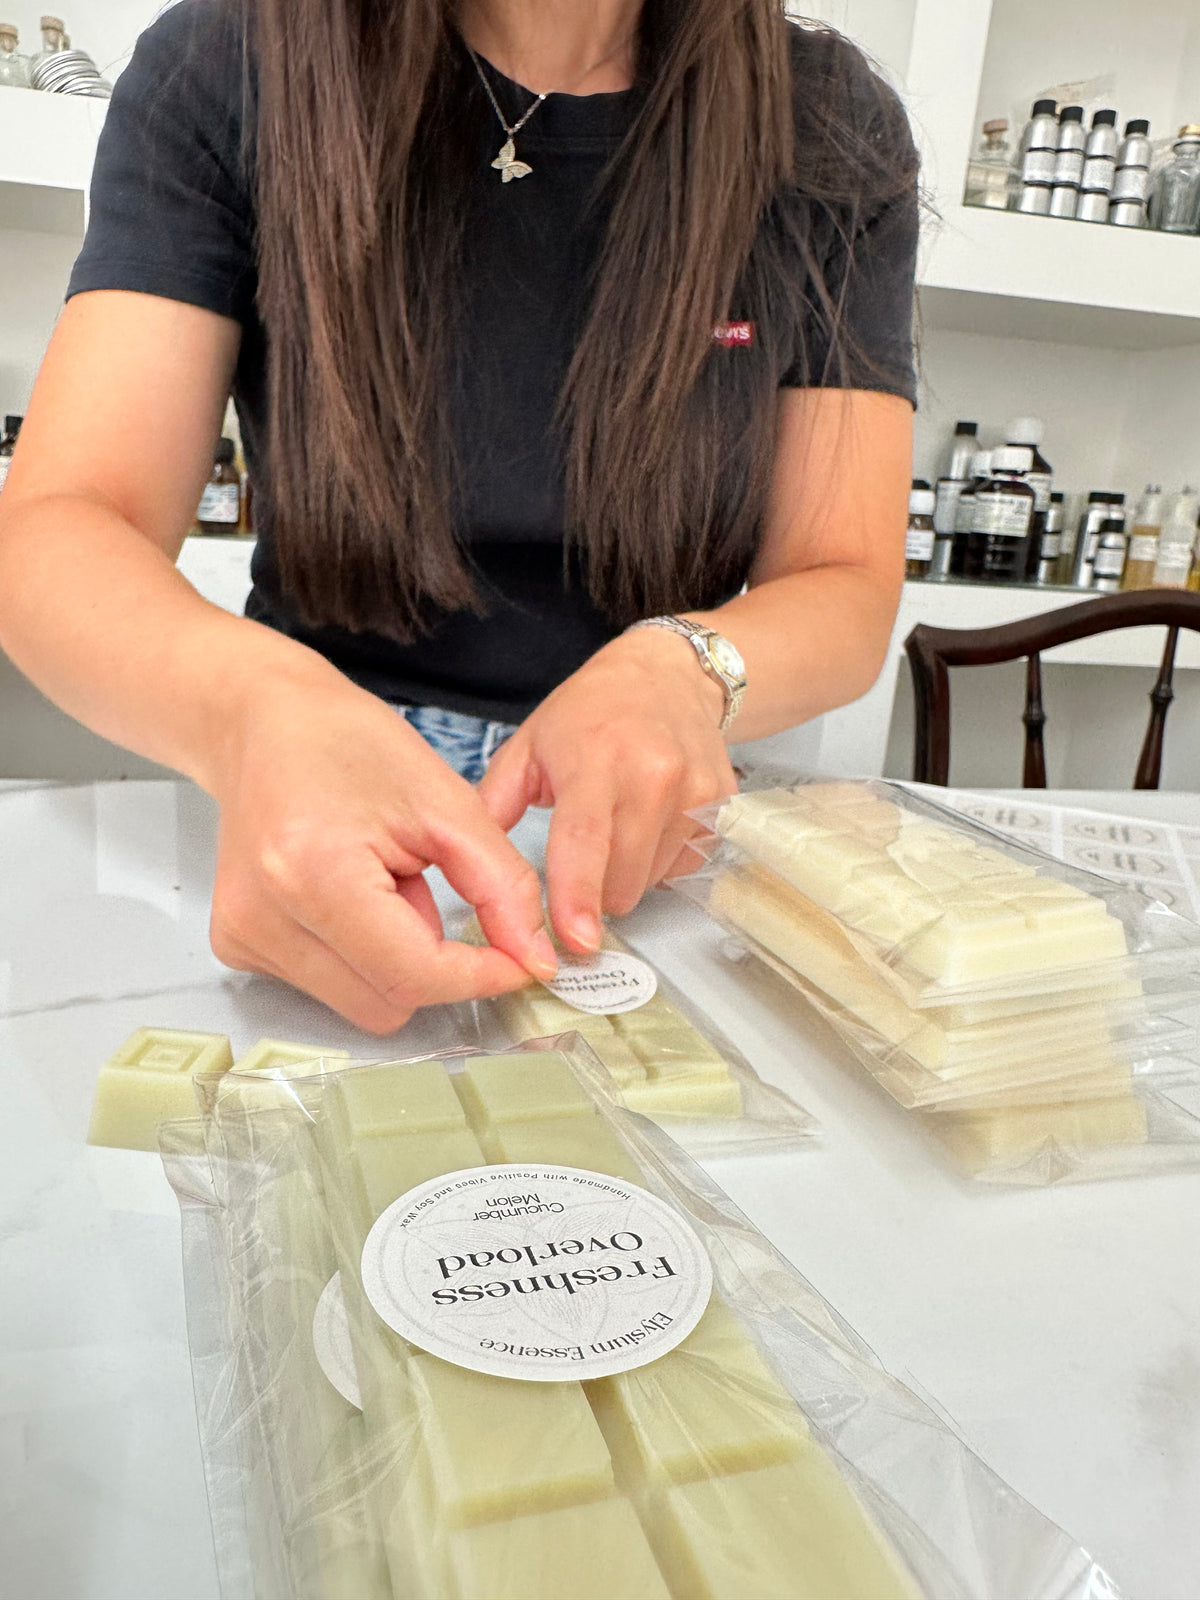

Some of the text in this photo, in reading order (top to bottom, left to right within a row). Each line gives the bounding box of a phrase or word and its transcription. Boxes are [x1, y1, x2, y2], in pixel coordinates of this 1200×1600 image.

[400, 1173, 631, 1228] Handmade with Positive Vibes and Soy Wax
[472, 1202, 564, 1221] Cucumber
[485, 1193, 541, 1207] Melon
[436, 1231, 643, 1279] Overload
[431, 1256, 678, 1305] Freshness
[480, 1311, 674, 1360] Elysium Essence
